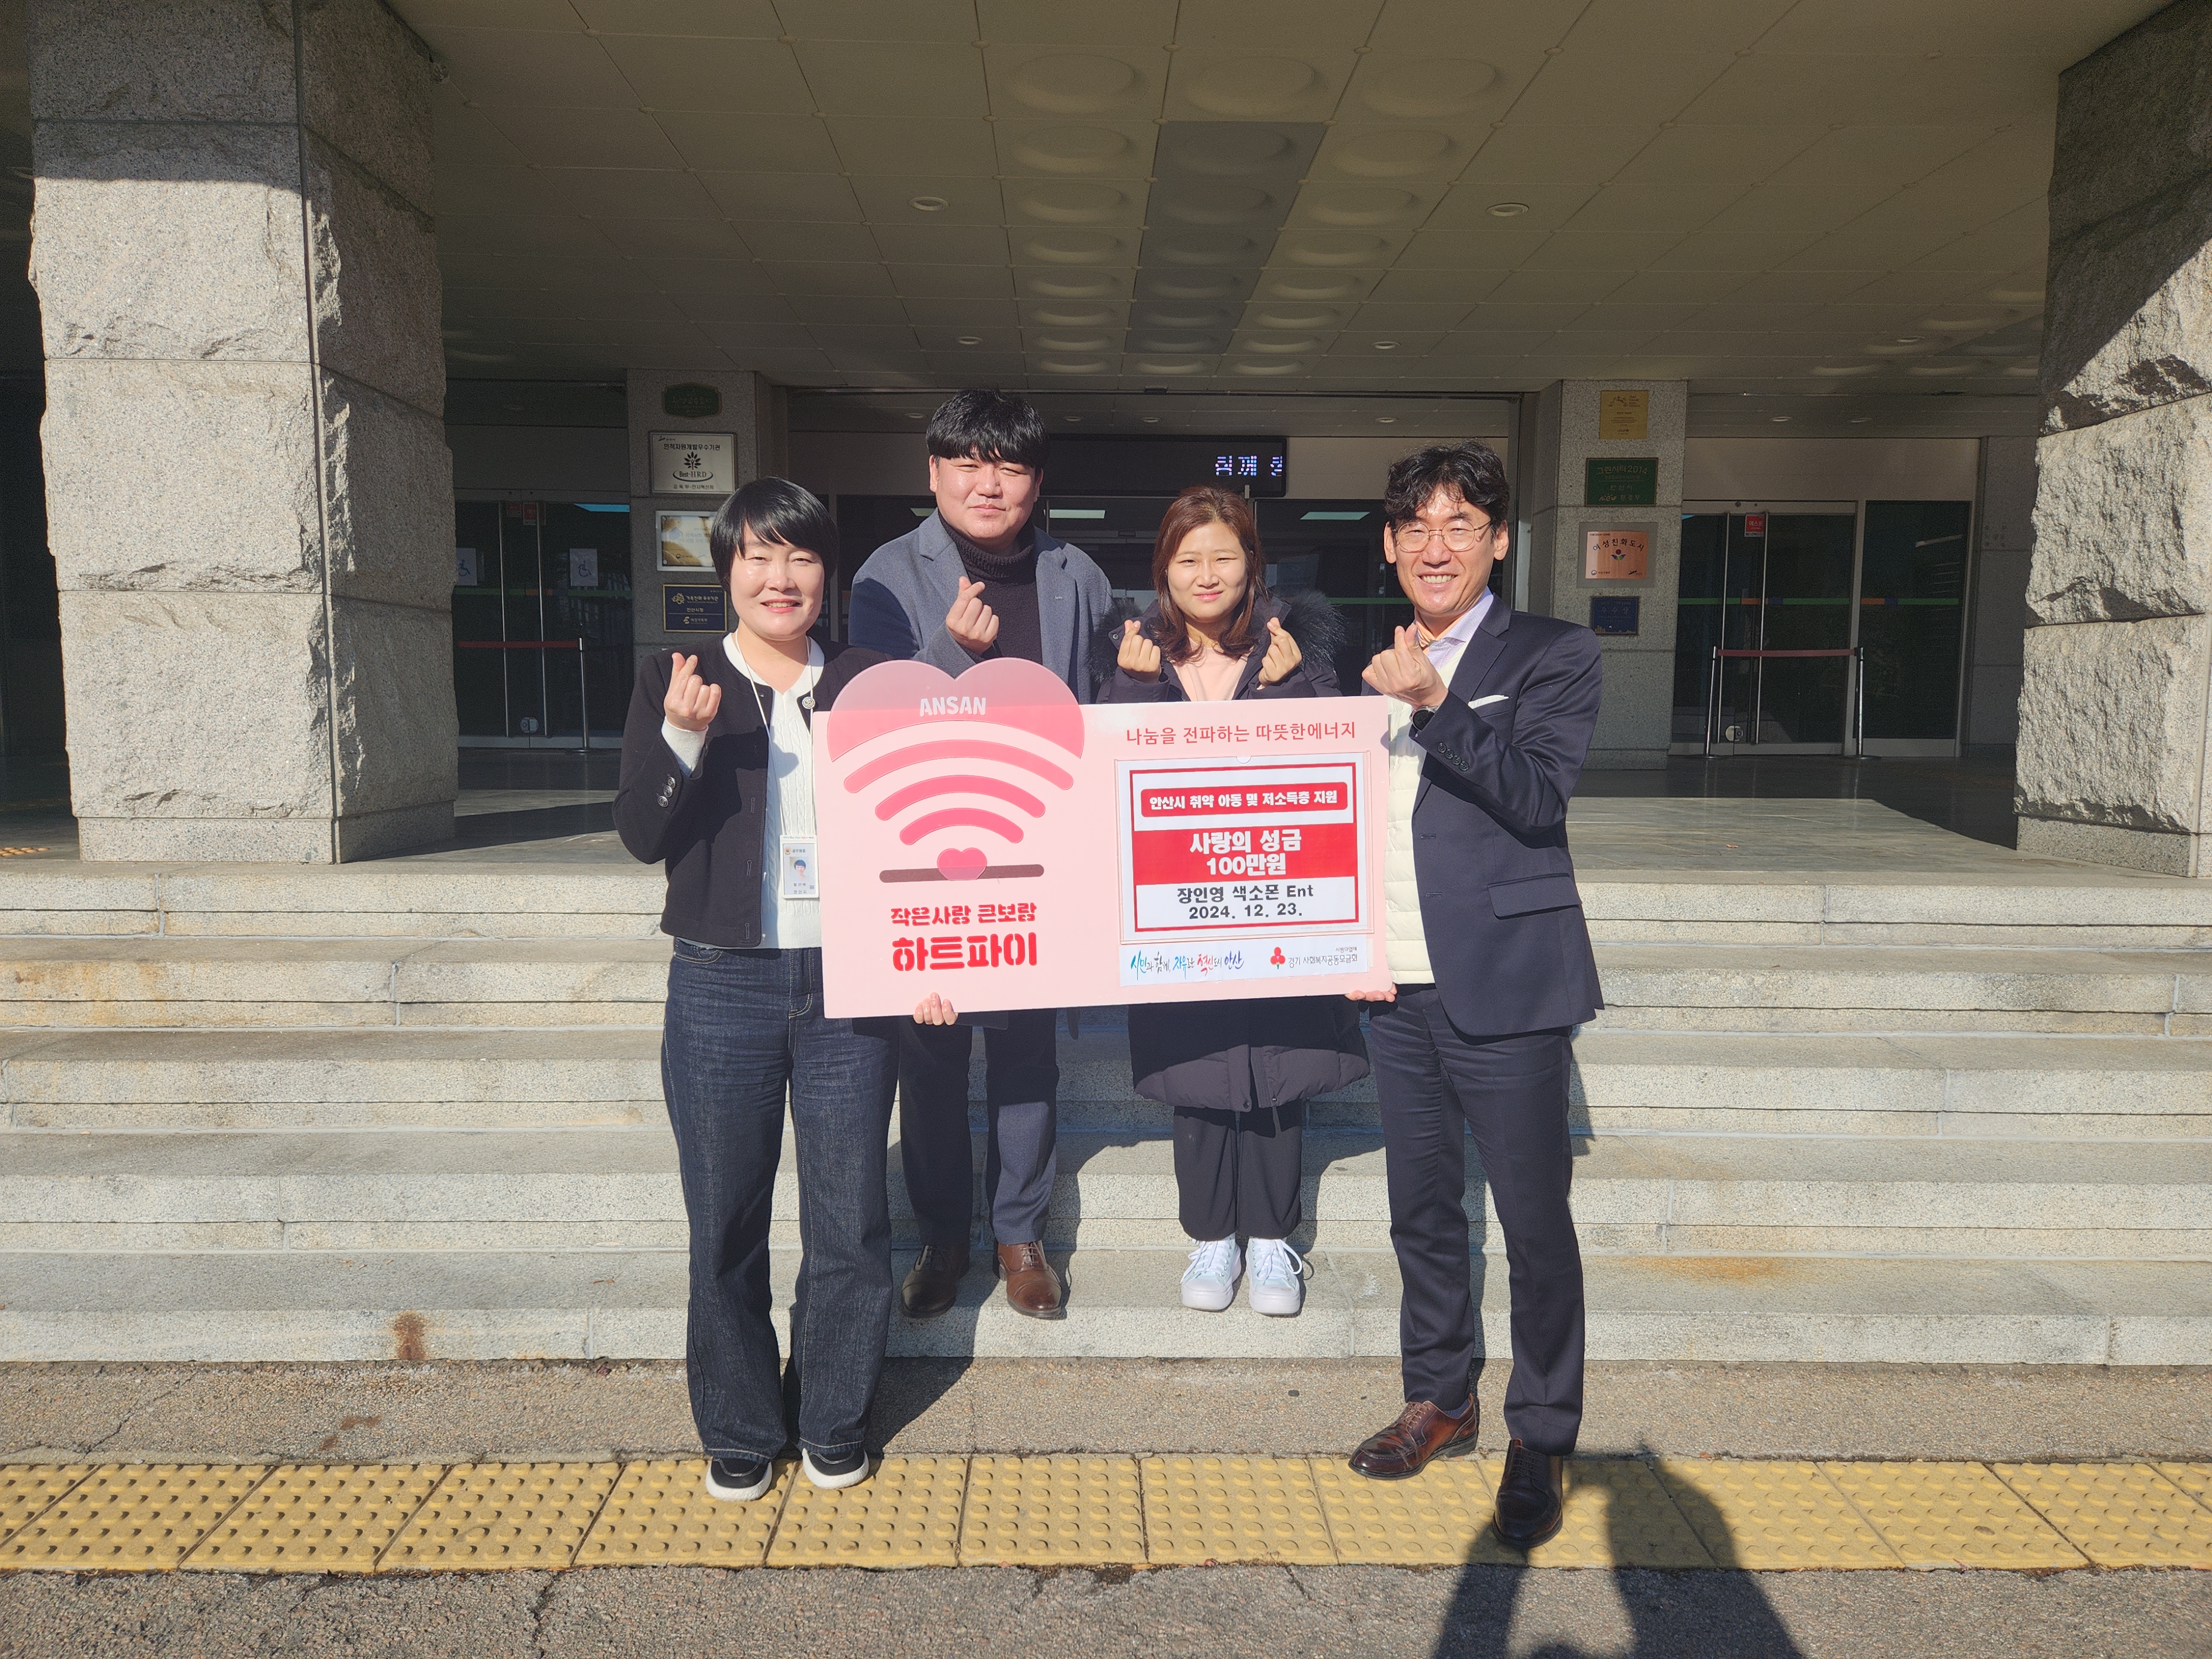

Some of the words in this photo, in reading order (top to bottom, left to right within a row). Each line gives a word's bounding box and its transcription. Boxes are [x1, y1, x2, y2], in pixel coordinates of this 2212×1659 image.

[1597, 465, 1648, 474] 그린시티2014
[1593, 539, 1644, 551] 여성친화도시
[920, 696, 986, 717] ANSAN
[1126, 727, 1176, 745] 나눔을
[1183, 725, 1249, 743] 전파하는
[1256, 722, 1355, 741] 따뜻한에너지
[1149, 795, 1186, 810] 안산시
[1190, 795, 1214, 808] 취약
[1218, 794, 1242, 807] 아동
[1246, 792, 1258, 807] 및
[1262, 791, 1310, 806] 저소득층
[1313, 790, 1337, 804] 지원
[1190, 831, 1251, 854] 사랑의
[1260, 829, 1302, 852] 성금
[1207, 853, 1286, 877] 100만원
[1177, 886, 1224, 904] 장인영
[1232, 884, 1280, 901] 색소폰
[1286, 884, 1314, 898] Ent
[890, 905, 972, 927] 작은사랑
[977, 902, 1037, 924] 큰보람
[1189, 905, 1235, 919] 2024.
[1244, 904, 1269, 917] 12.
[1277, 902, 1302, 916] 23.
[892, 932, 1037, 972] 하트파이
[1288, 957, 1301, 968] 경기
[1302, 954, 1358, 966] 사회복지공동모금회
[1130, 950, 1154, 980] 시민과
[1172, 955, 1195, 979] 자유로운
[1197, 953, 1222, 977] 혁신도시
[1224, 950, 1245, 970] 안산
